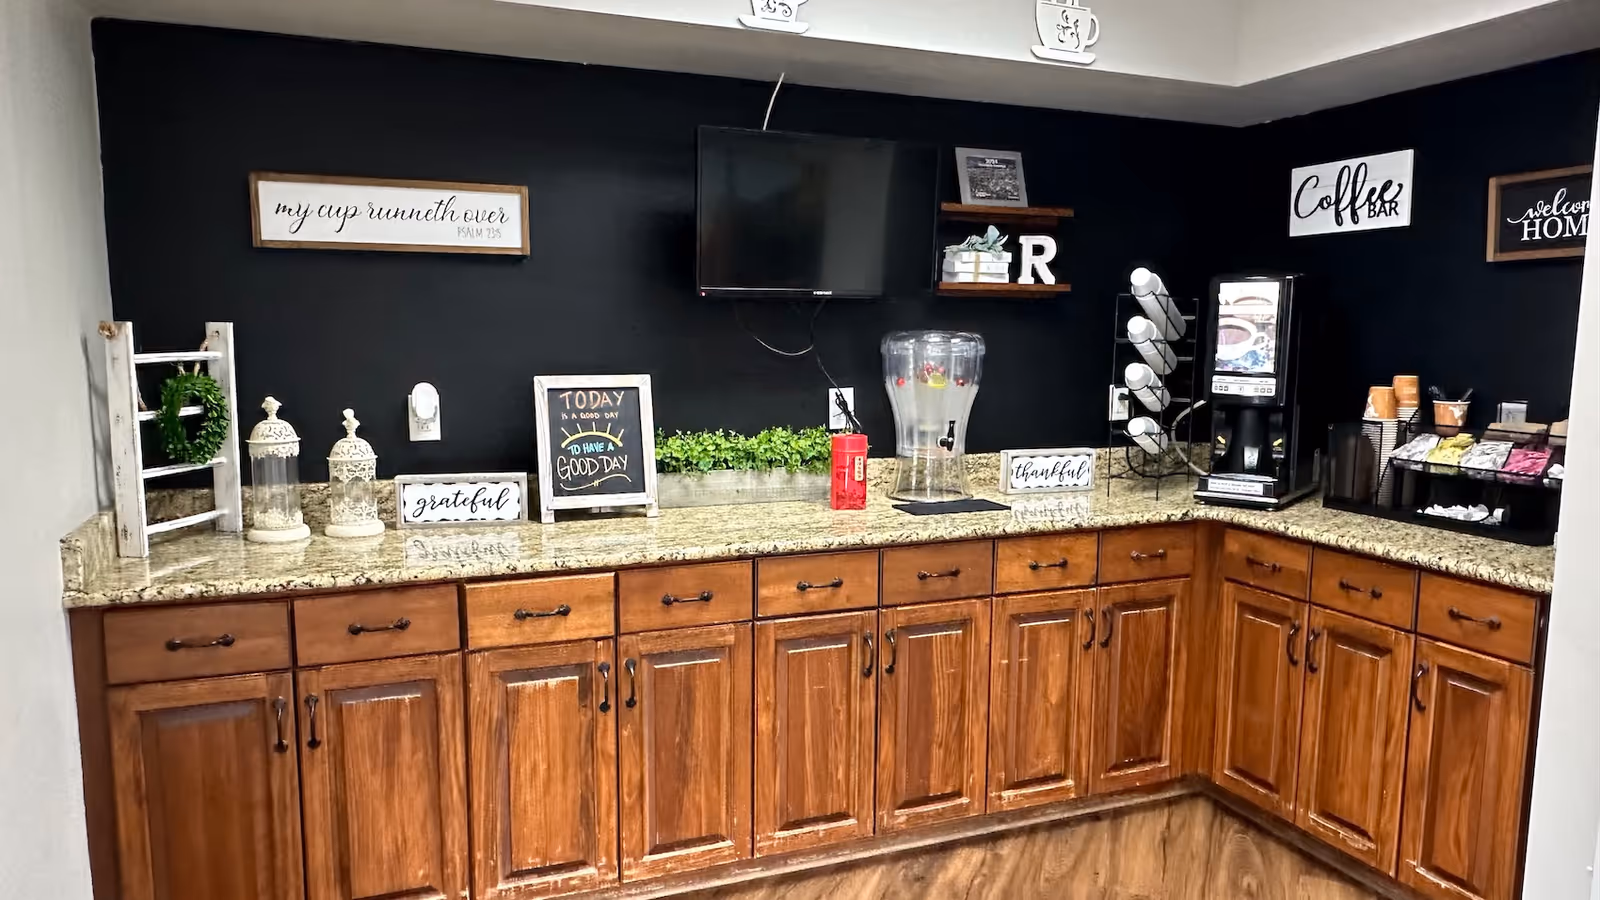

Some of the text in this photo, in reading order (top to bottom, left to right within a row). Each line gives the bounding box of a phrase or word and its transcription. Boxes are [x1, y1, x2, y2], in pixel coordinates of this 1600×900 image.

[1294, 162, 1403, 226] Coffee
[275, 195, 509, 234] my cup runneth over
[1367, 201, 1399, 219] BAR
[1521, 213, 1589, 241] HOM
[1018, 234, 1057, 285] R
[560, 390, 625, 410] TODAY
[571, 412, 578, 420] A
[604, 411, 619, 420] DAY
[567, 441, 615, 456] TO HAVE A
[557, 454, 628, 481] GOOD DAY
[1014, 460, 1088, 482] thankful
[412, 486, 510, 518] grateful
